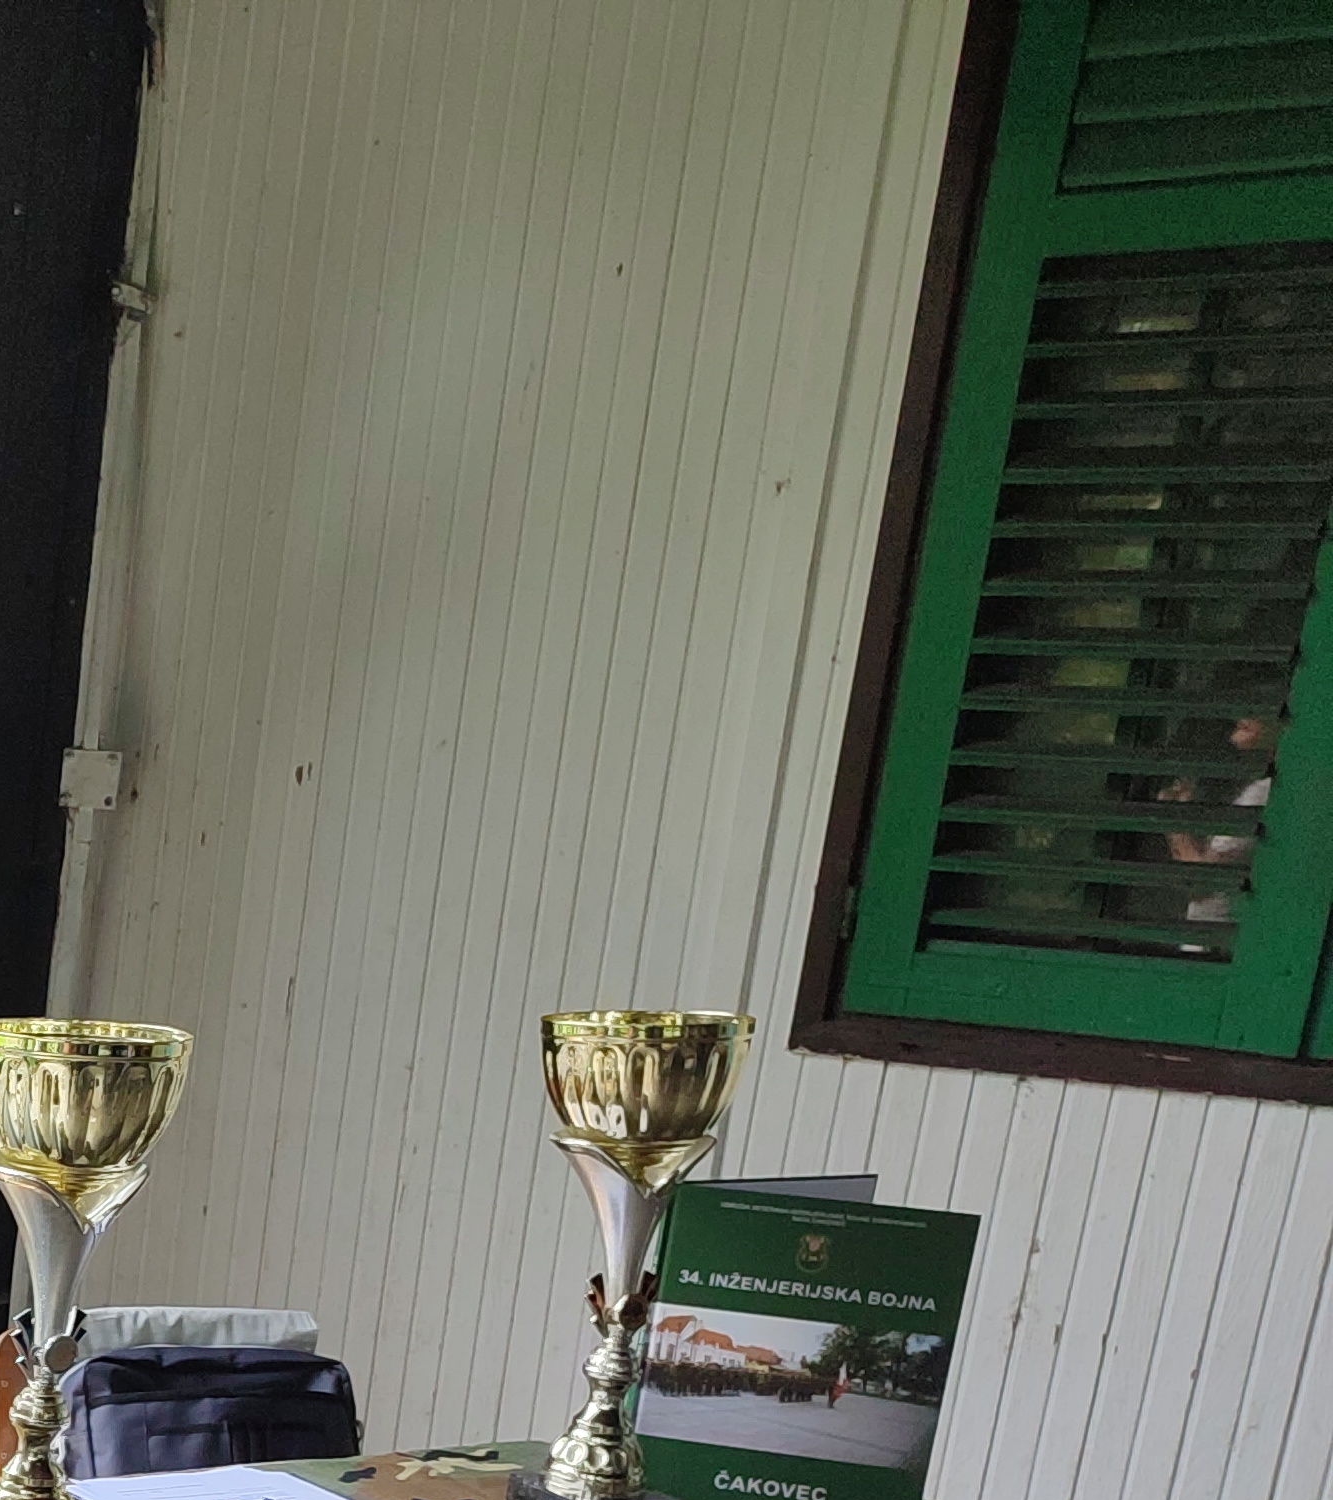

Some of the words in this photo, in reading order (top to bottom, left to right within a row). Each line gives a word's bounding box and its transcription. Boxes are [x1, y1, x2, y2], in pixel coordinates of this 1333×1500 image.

[678, 1269, 705, 1287] 34.
[708, 1271, 863, 1305] INŽENJERIJSKA
[867, 1290, 937, 1312] BOJNA
